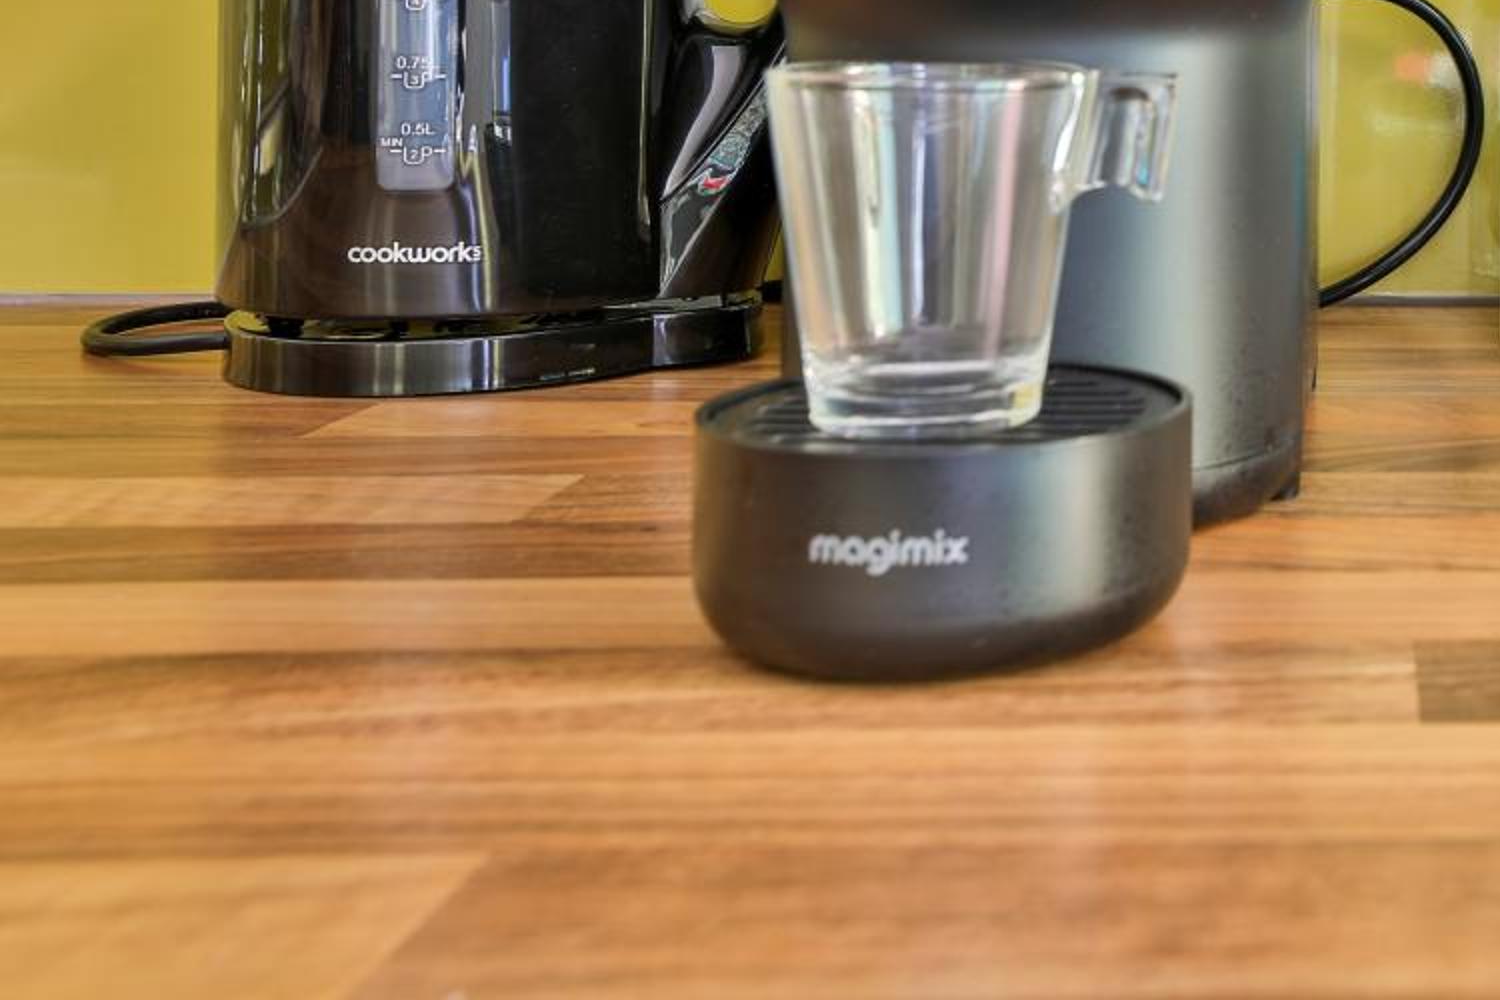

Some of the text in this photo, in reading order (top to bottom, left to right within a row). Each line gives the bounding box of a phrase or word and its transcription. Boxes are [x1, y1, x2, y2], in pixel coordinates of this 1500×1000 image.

[401, 122, 435, 136] 0.5L
[380, 137, 403, 147] MIN
[347, 241, 482, 263] cookworks
[807, 527, 970, 577] magimix
